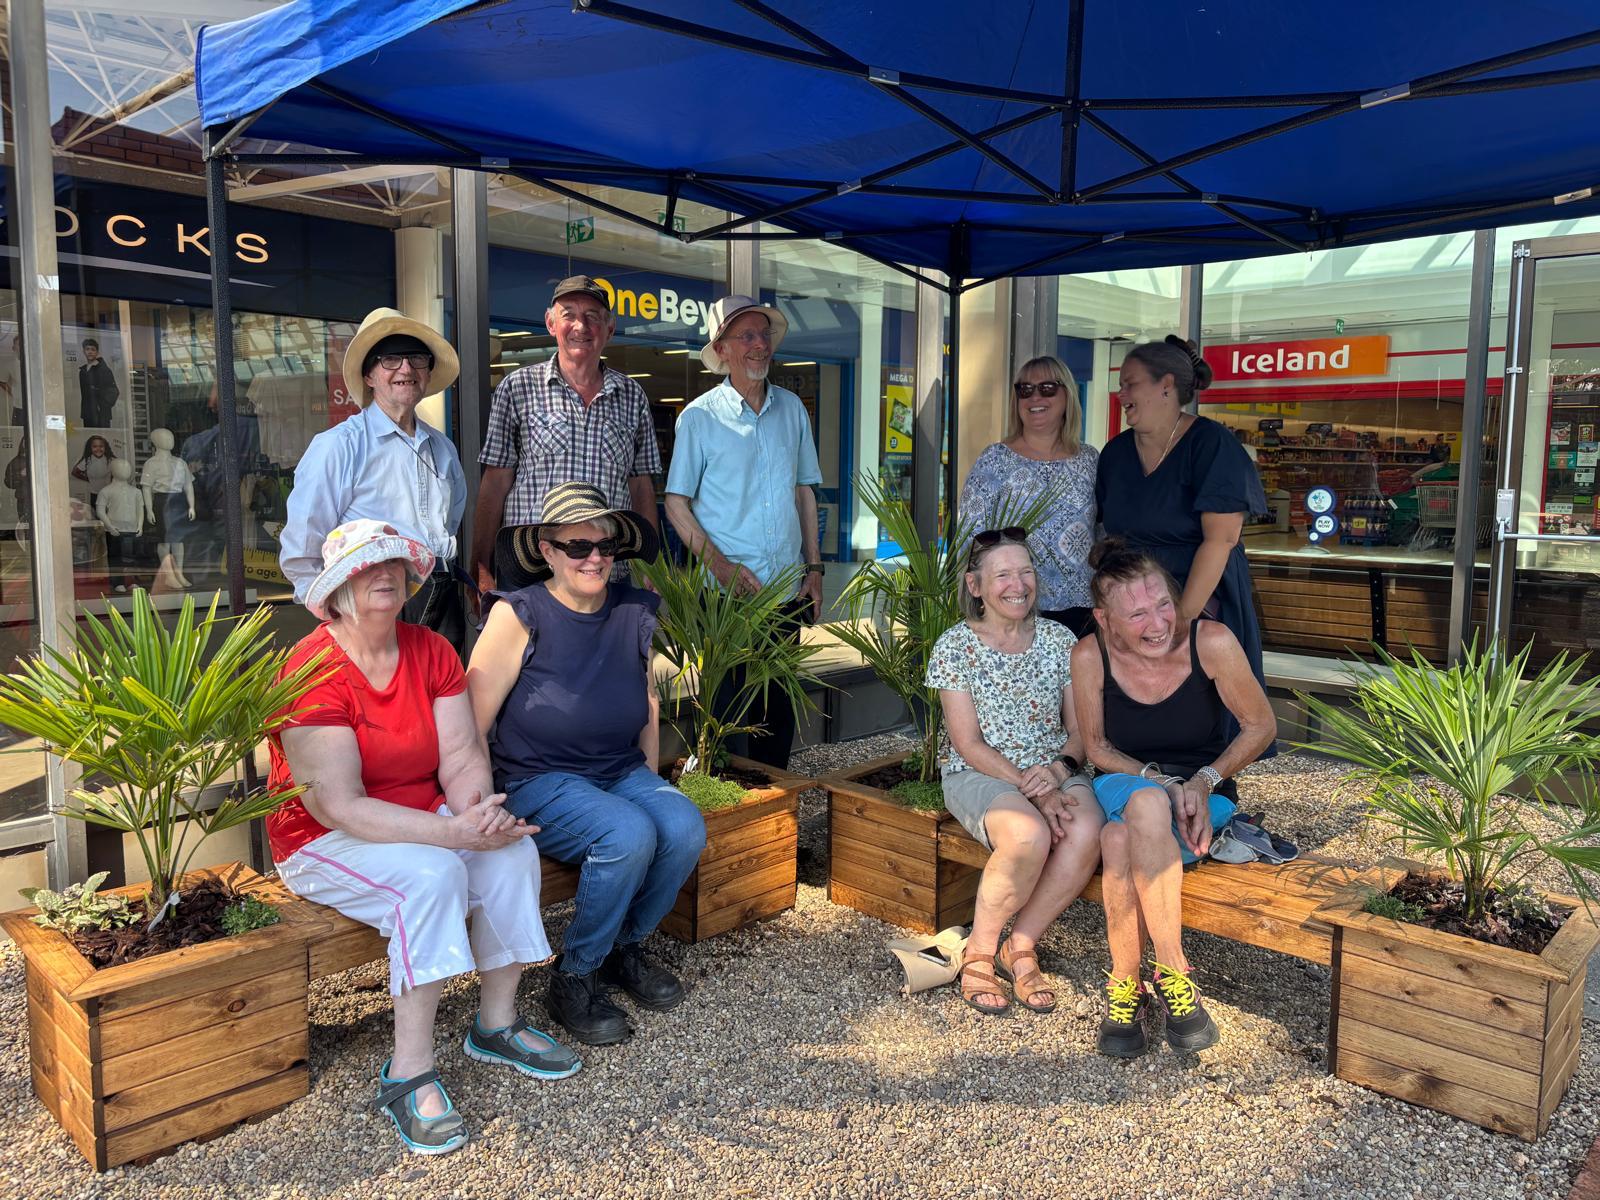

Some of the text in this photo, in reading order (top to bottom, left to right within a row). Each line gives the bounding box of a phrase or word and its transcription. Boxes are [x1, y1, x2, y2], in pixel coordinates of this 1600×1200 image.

[1232, 344, 1350, 374] Iceland
[889, 373, 908, 383] MEGA
[256, 568, 278, 579] age
